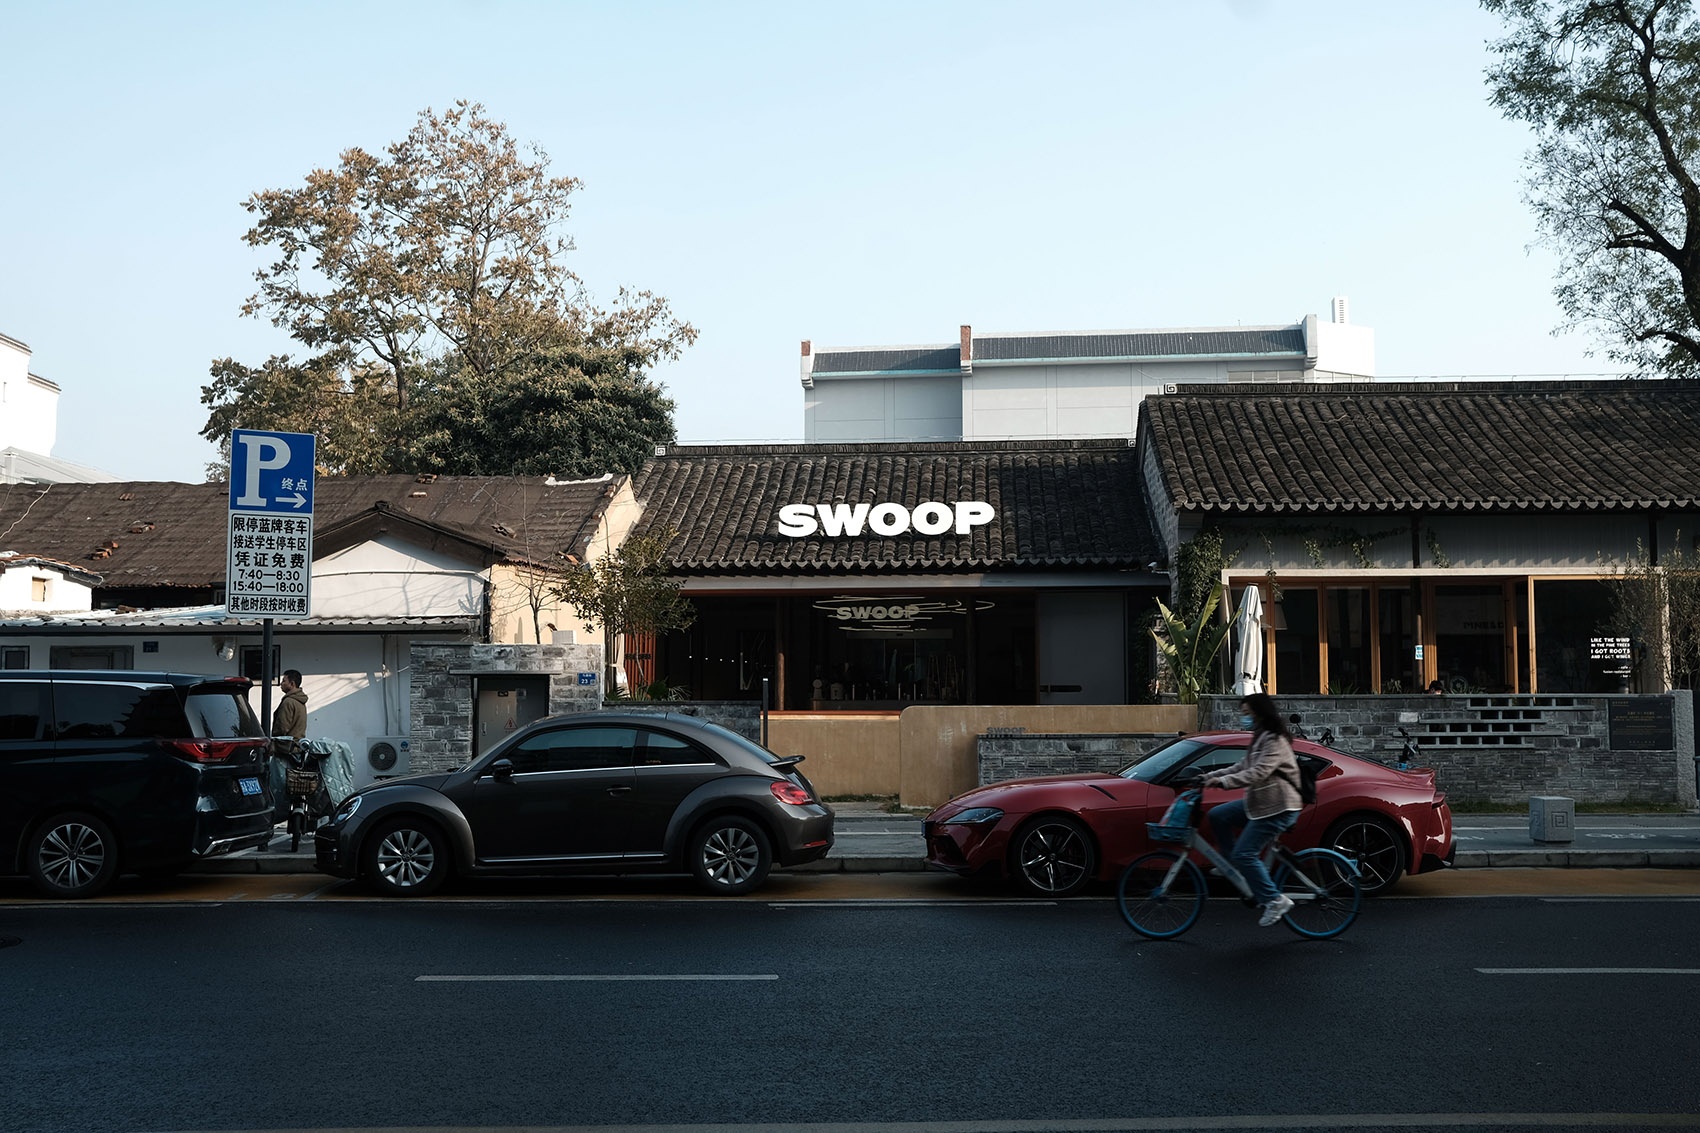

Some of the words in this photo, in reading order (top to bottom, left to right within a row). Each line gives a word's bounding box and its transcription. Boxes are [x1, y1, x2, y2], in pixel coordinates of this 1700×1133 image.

[236, 434, 291, 507] P
[281, 477, 308, 491] 终点
[233, 516, 308, 535] 限停蓝牌客车
[778, 501, 996, 537] SWOOP
[233, 534, 307, 552] 接送学生停车区
[234, 551, 305, 570] 凭证免费
[231, 595, 306, 613] 其他时段按时收费
[836, 605, 920, 620] SWOOP
[986, 726, 1026, 735] SWOOP
